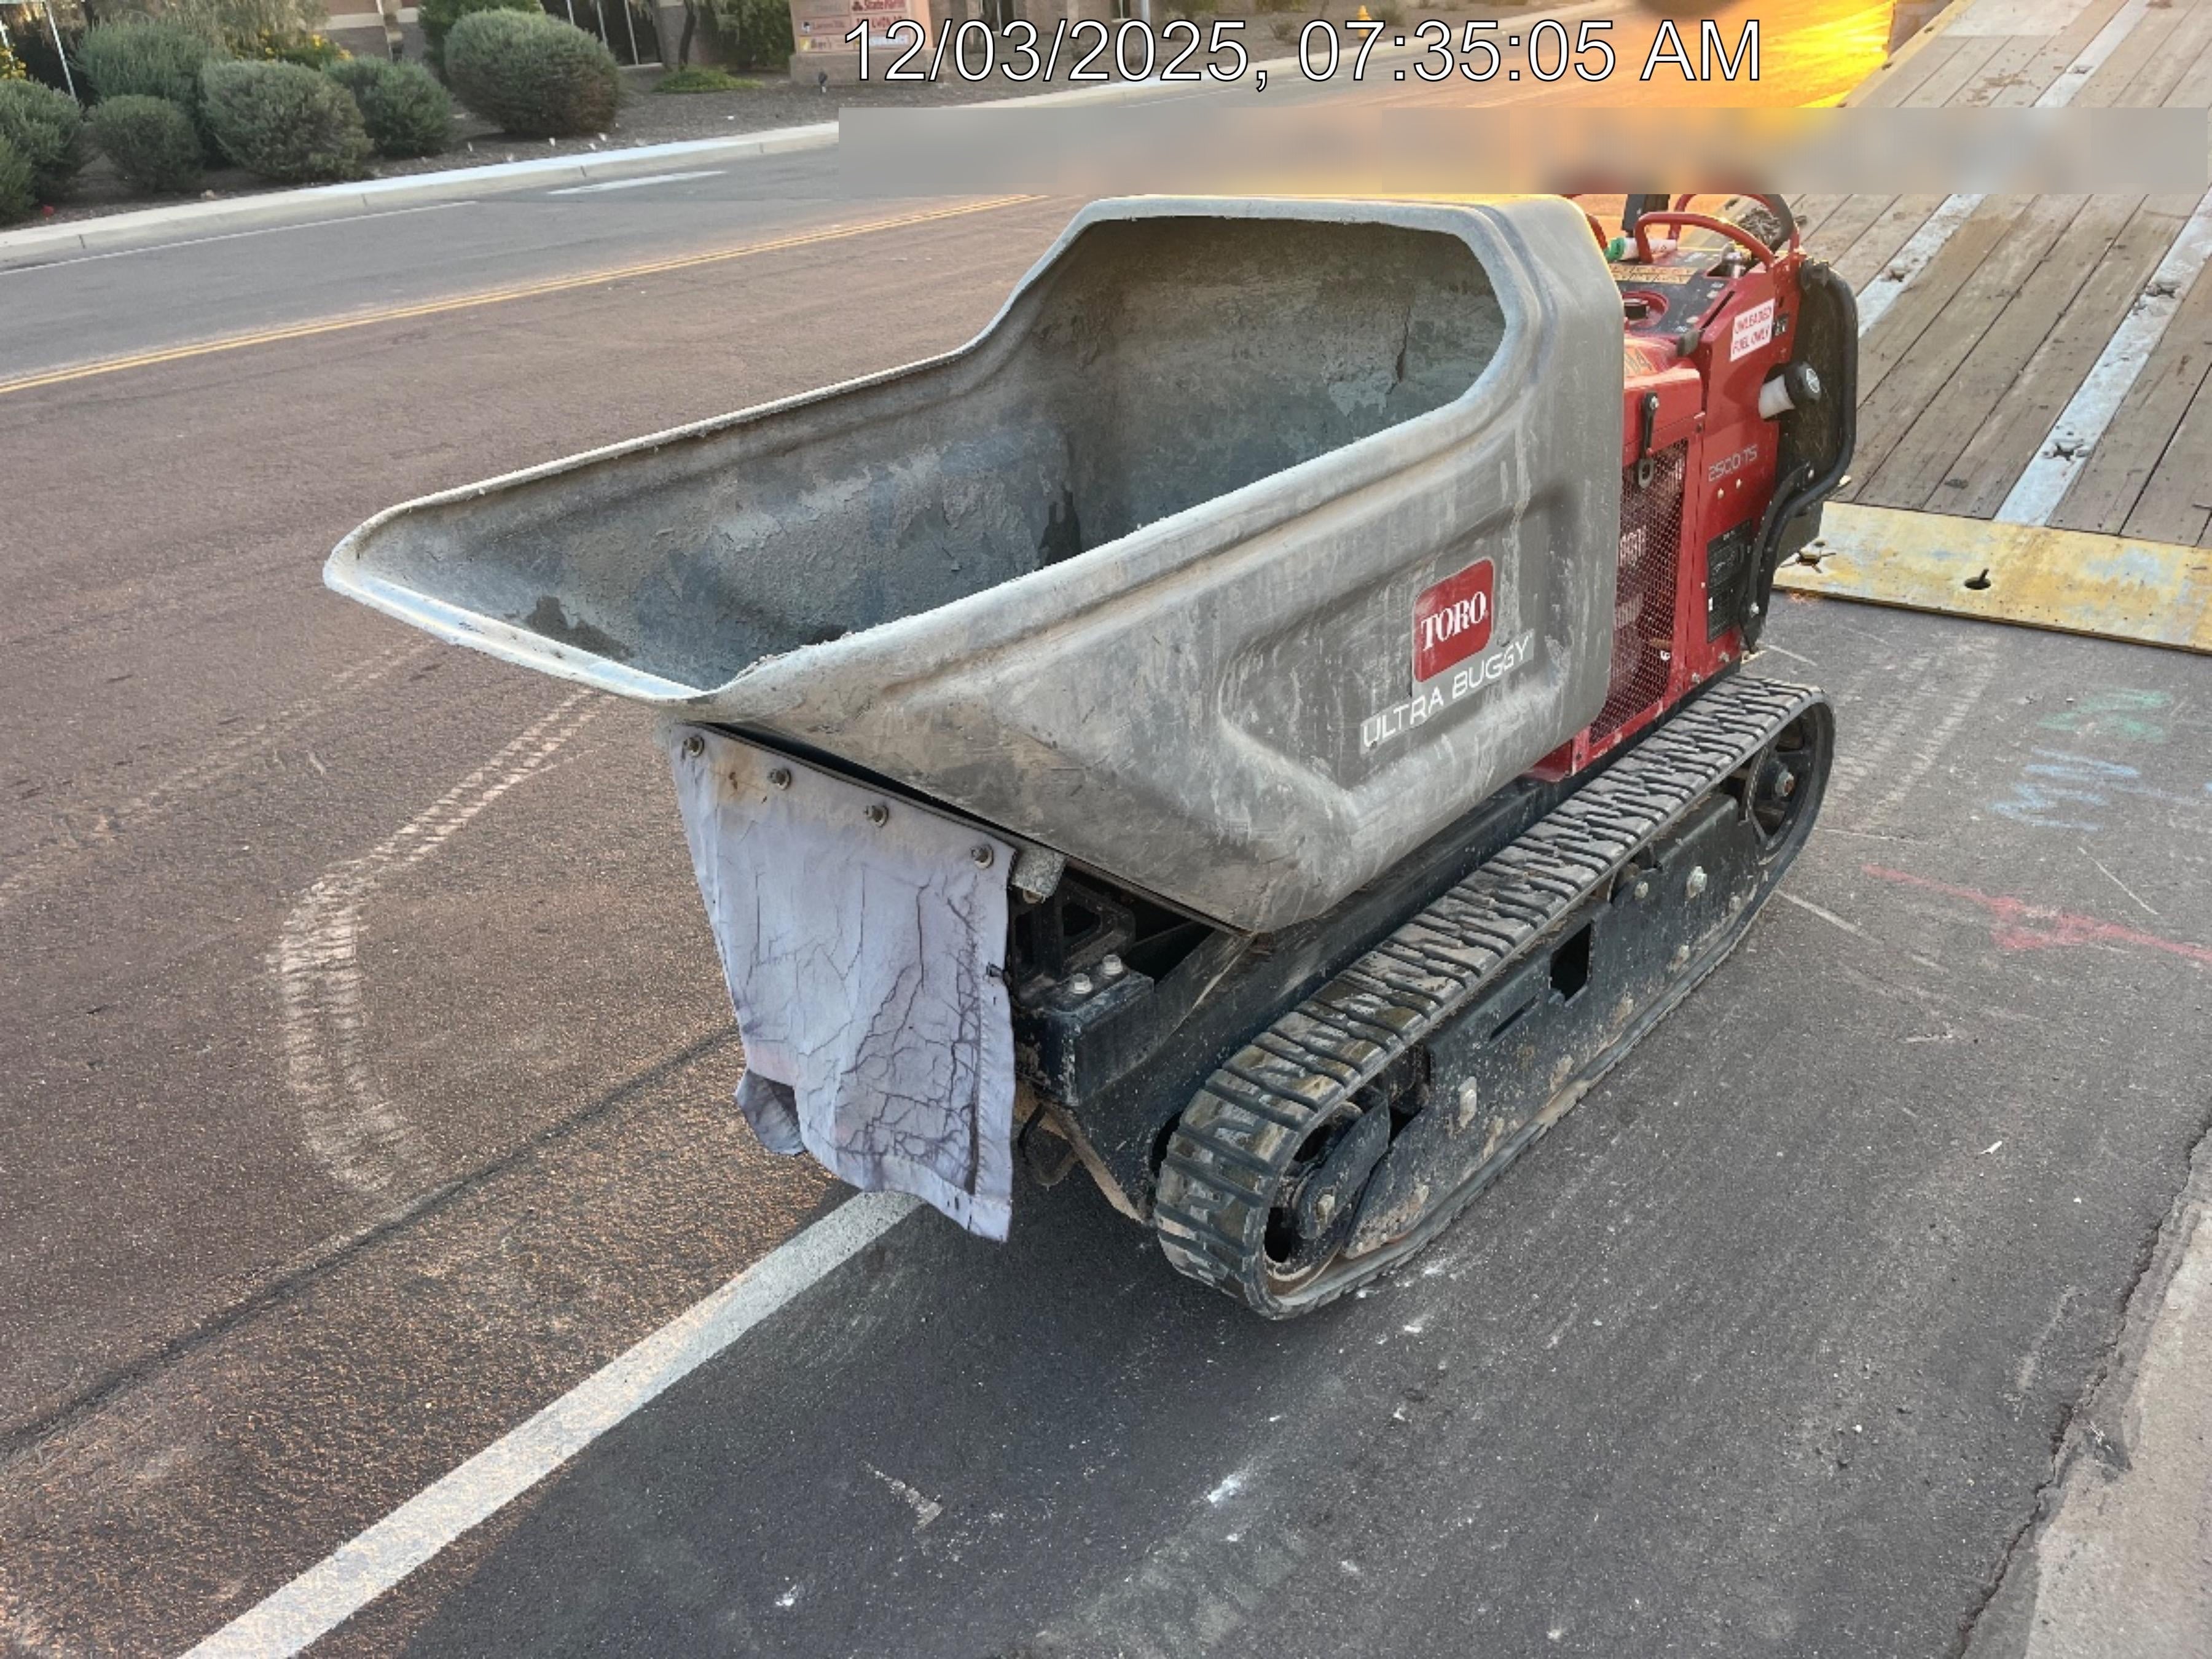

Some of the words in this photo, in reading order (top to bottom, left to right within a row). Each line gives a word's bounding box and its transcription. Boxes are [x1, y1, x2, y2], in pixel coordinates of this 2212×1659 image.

[1732, 336, 1750, 355] FUEL
[1421, 590, 1488, 652] TORO
[1363, 686, 1445, 747] ULTRA
[1452, 633, 1530, 699] BUGGY
